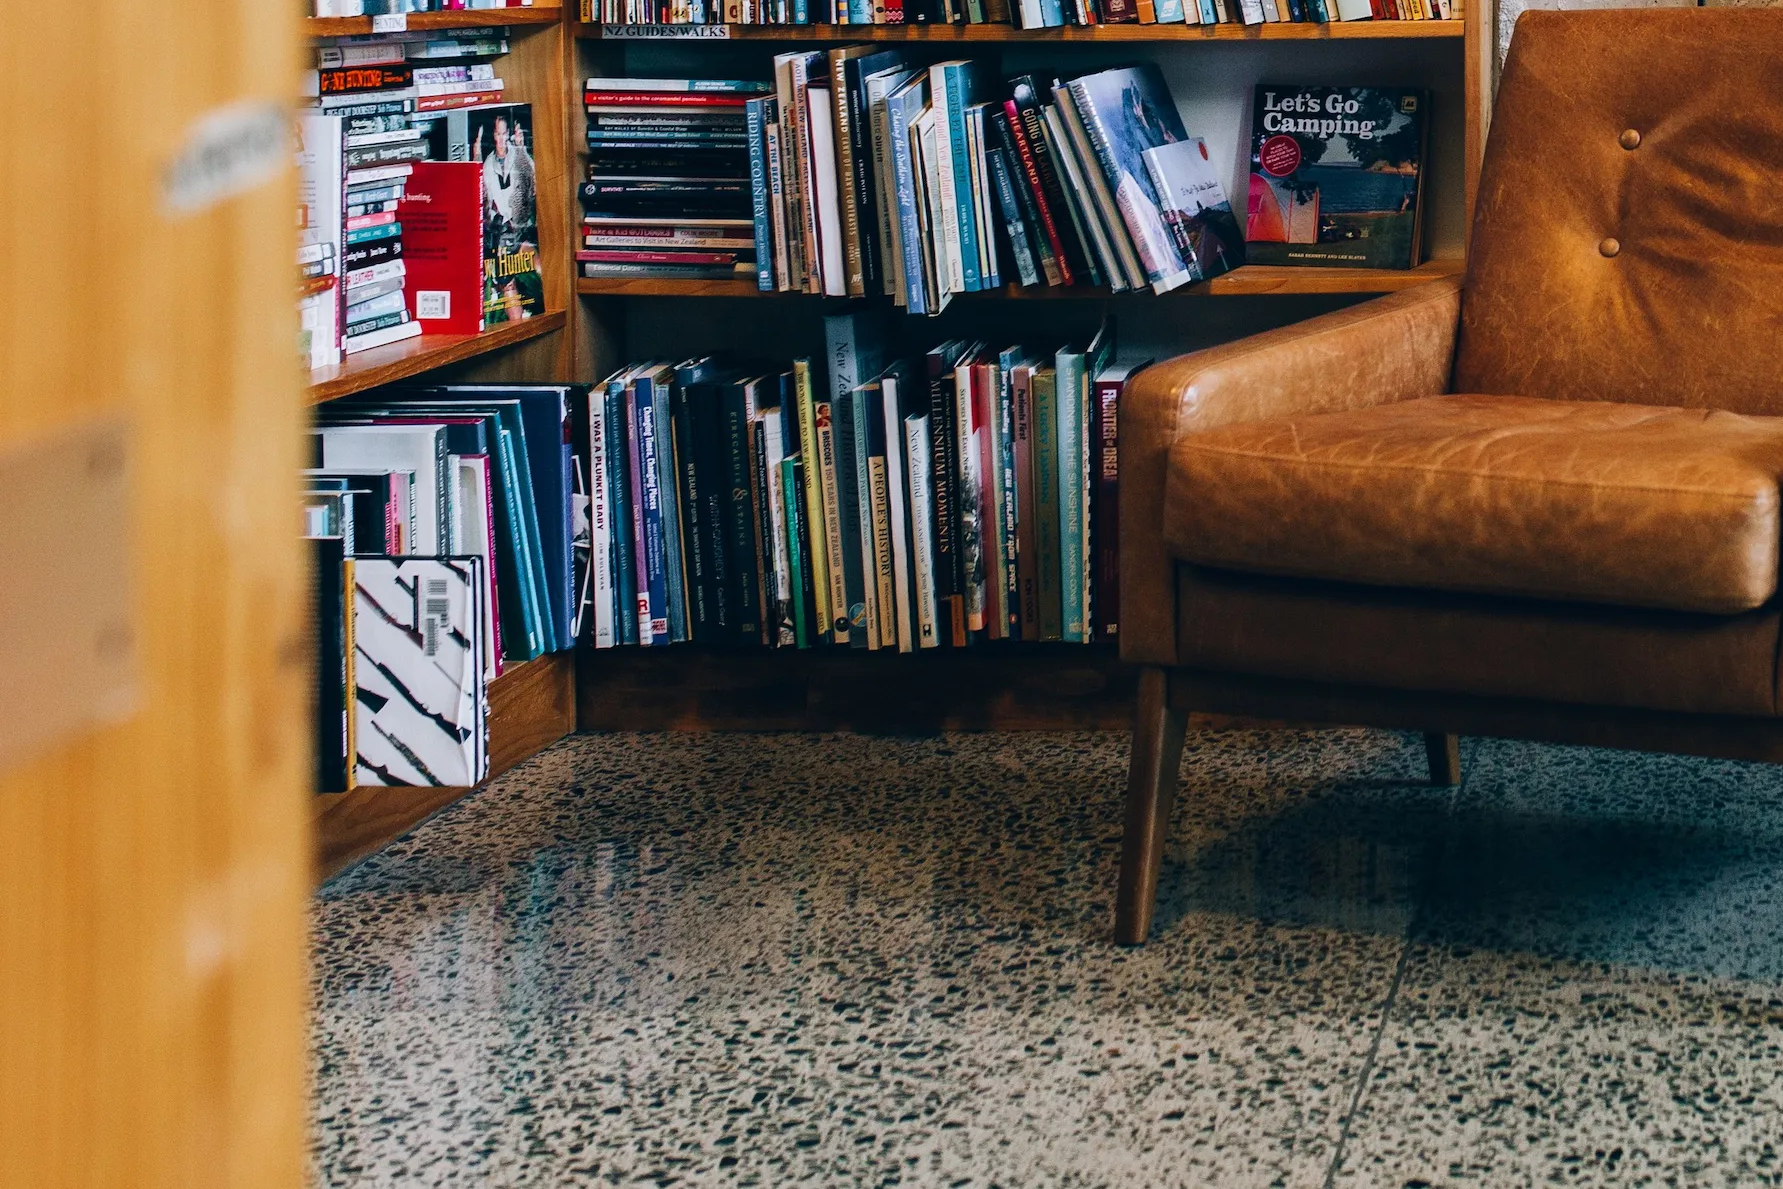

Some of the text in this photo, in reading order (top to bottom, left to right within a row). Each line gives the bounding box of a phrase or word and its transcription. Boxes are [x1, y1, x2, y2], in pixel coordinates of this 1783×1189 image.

[604, 25, 726, 37] NZ GUIDES/WALKS
[1263, 92, 1359, 114] Let's Go
[1263, 112, 1376, 140] Camping
[747, 112, 765, 218] RIDING COUNTRY
[498, 250, 535, 276] Hunter
[822, 431, 832, 466] BRISCOES
[873, 462, 891, 578] A PEOPLE'S HISTORY
